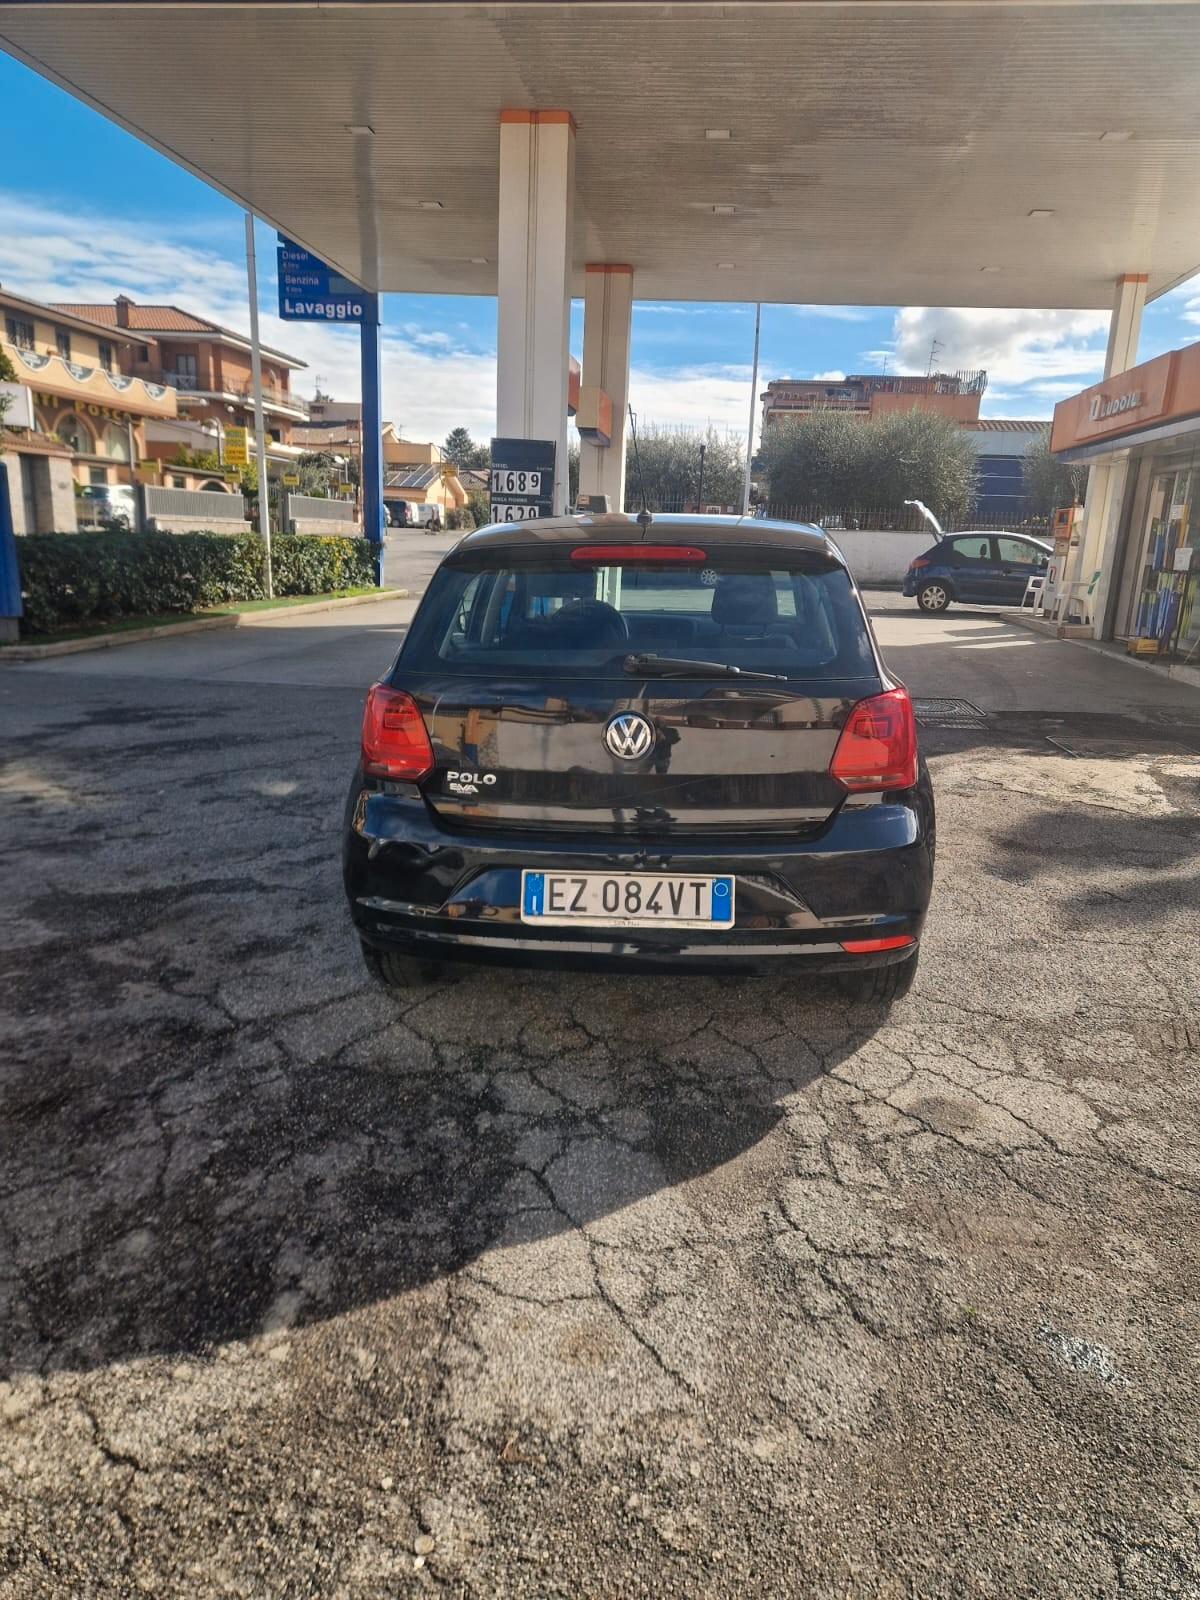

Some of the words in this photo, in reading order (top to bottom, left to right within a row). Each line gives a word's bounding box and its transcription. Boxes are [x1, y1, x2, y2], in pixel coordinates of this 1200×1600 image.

[281, 250, 309, 261] Diesel
[285, 275, 320, 286] Benzina
[284, 299, 363, 318] Lavaggio
[446, 771, 497, 785] POLO
[549, 878, 588, 912] EZ
[602, 879, 707, 916] 084VT
